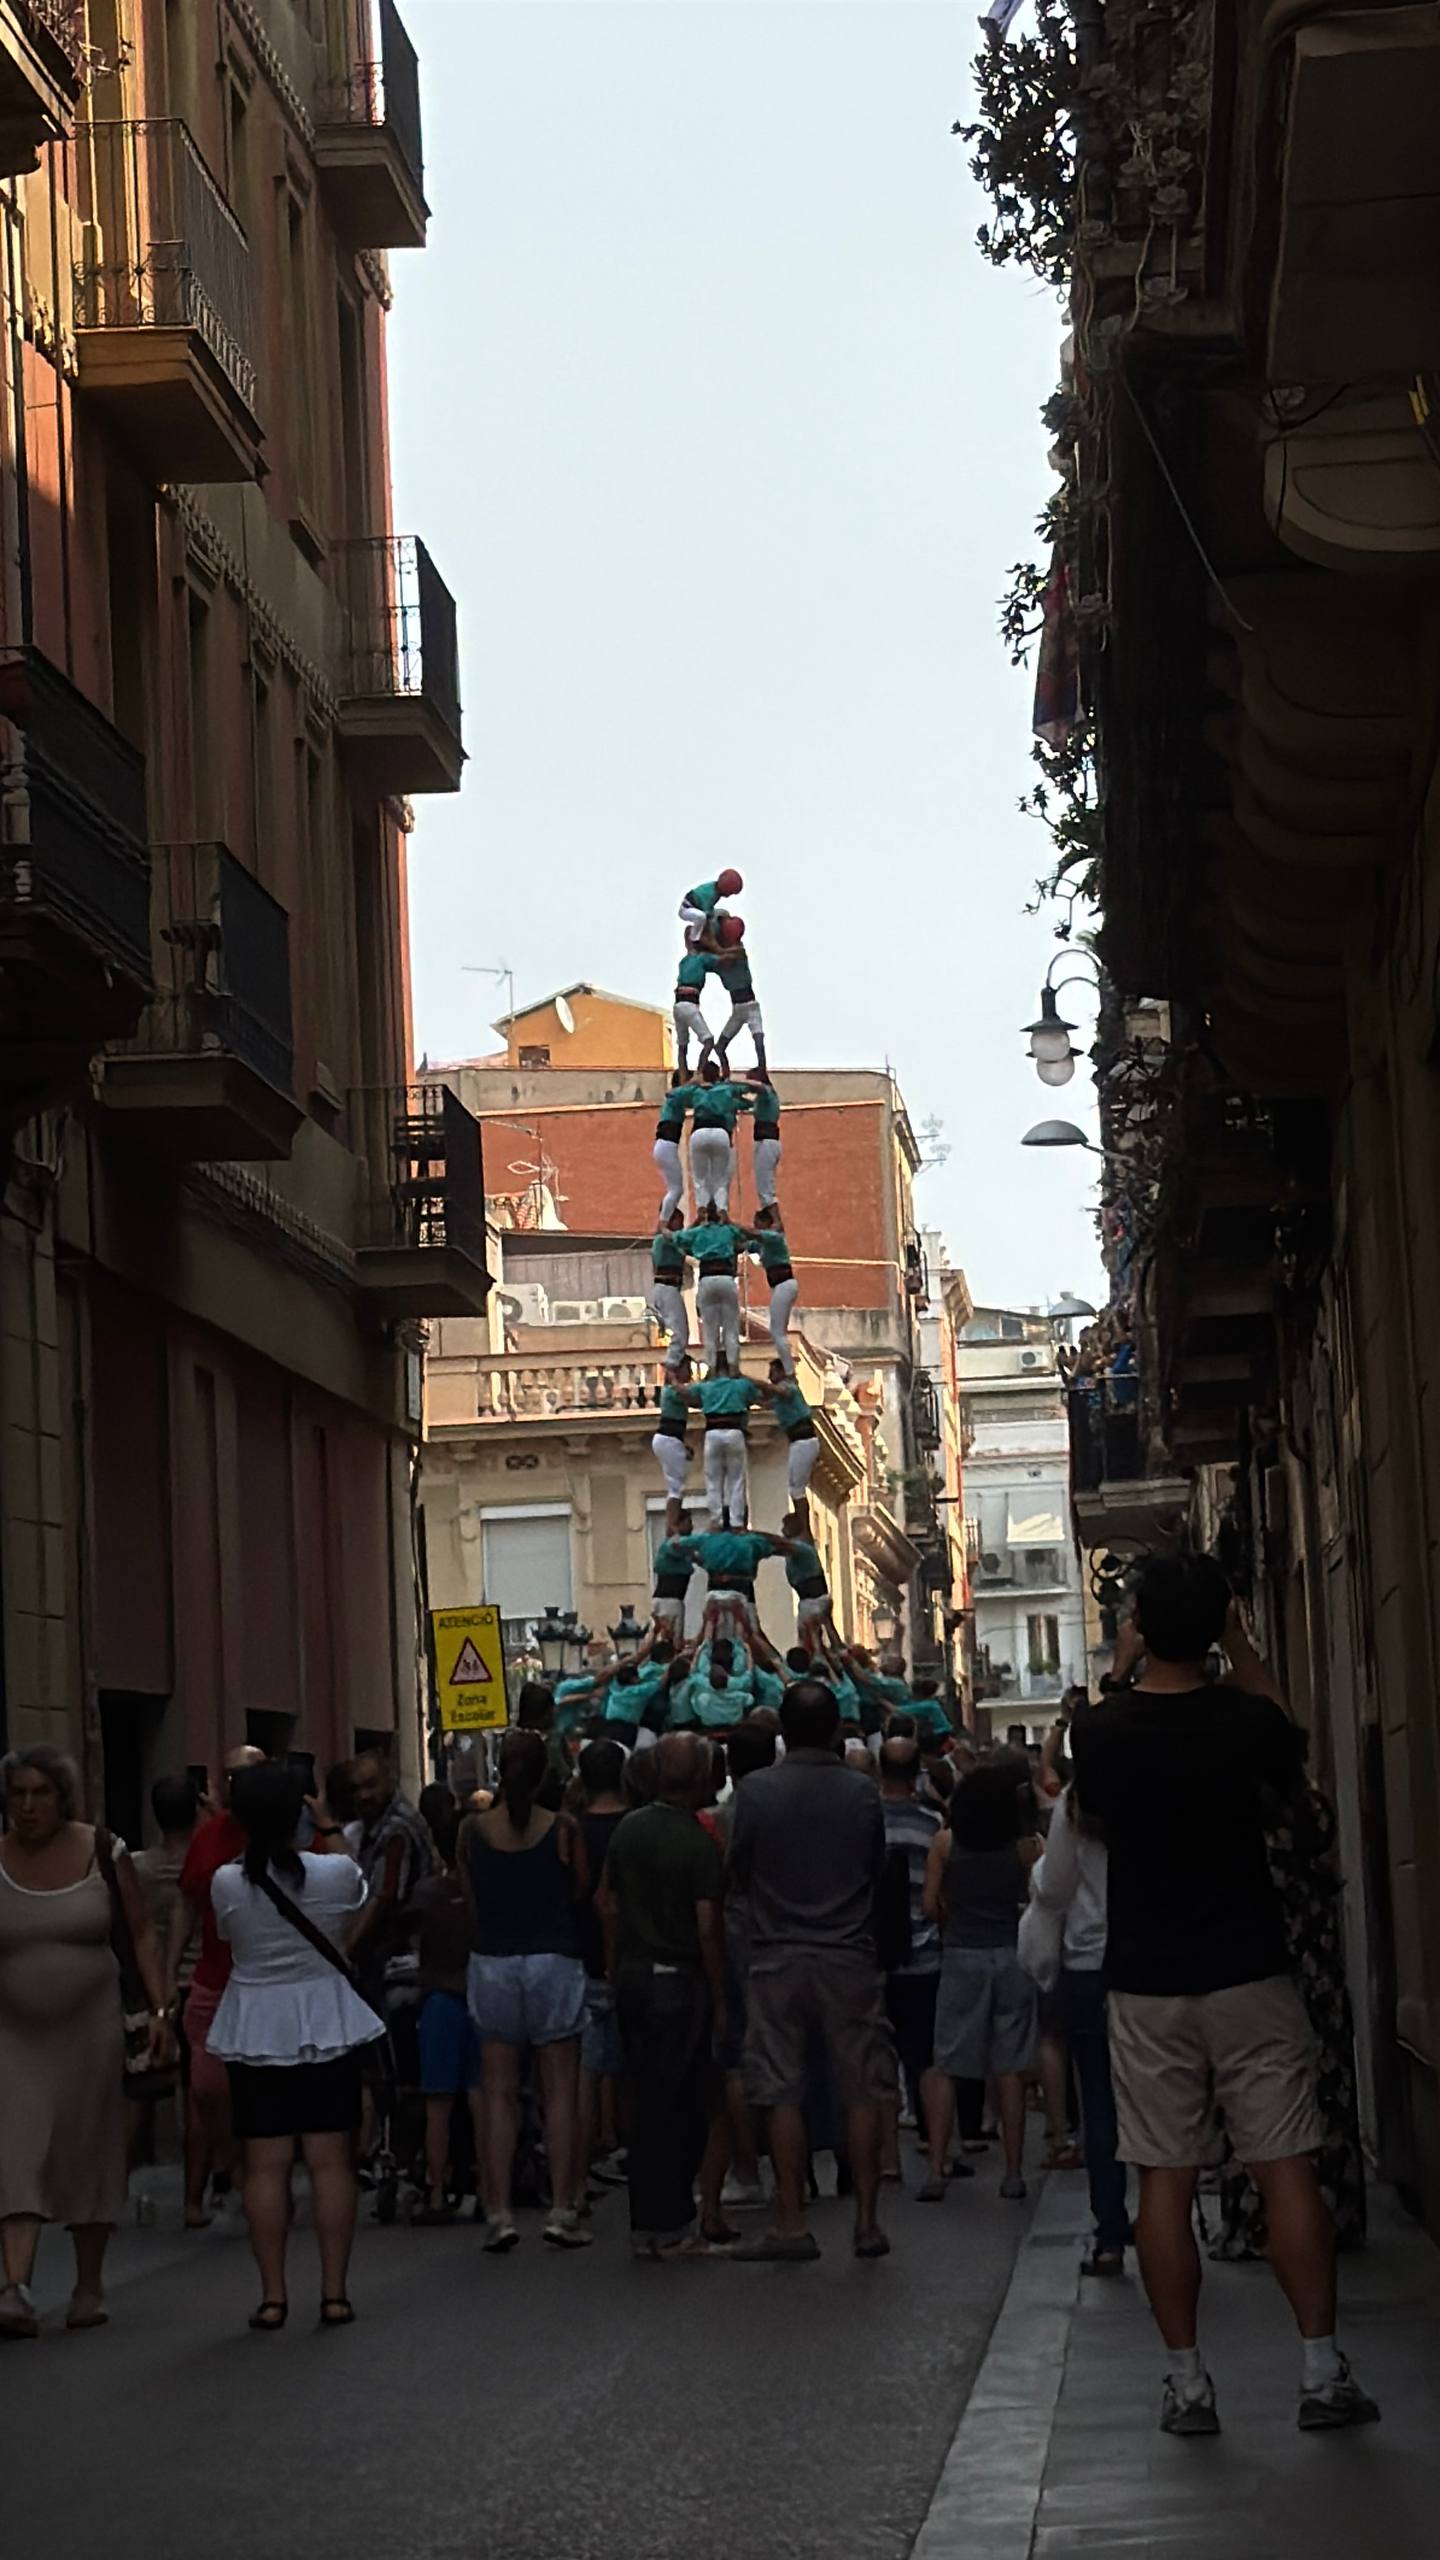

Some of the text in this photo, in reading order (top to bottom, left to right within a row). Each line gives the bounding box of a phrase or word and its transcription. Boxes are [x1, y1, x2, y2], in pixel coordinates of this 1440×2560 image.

[439, 1612, 494, 1627] ATENCIÓ
[457, 1693, 487, 1706] Zona
[451, 1709, 496, 1722] Escolar
